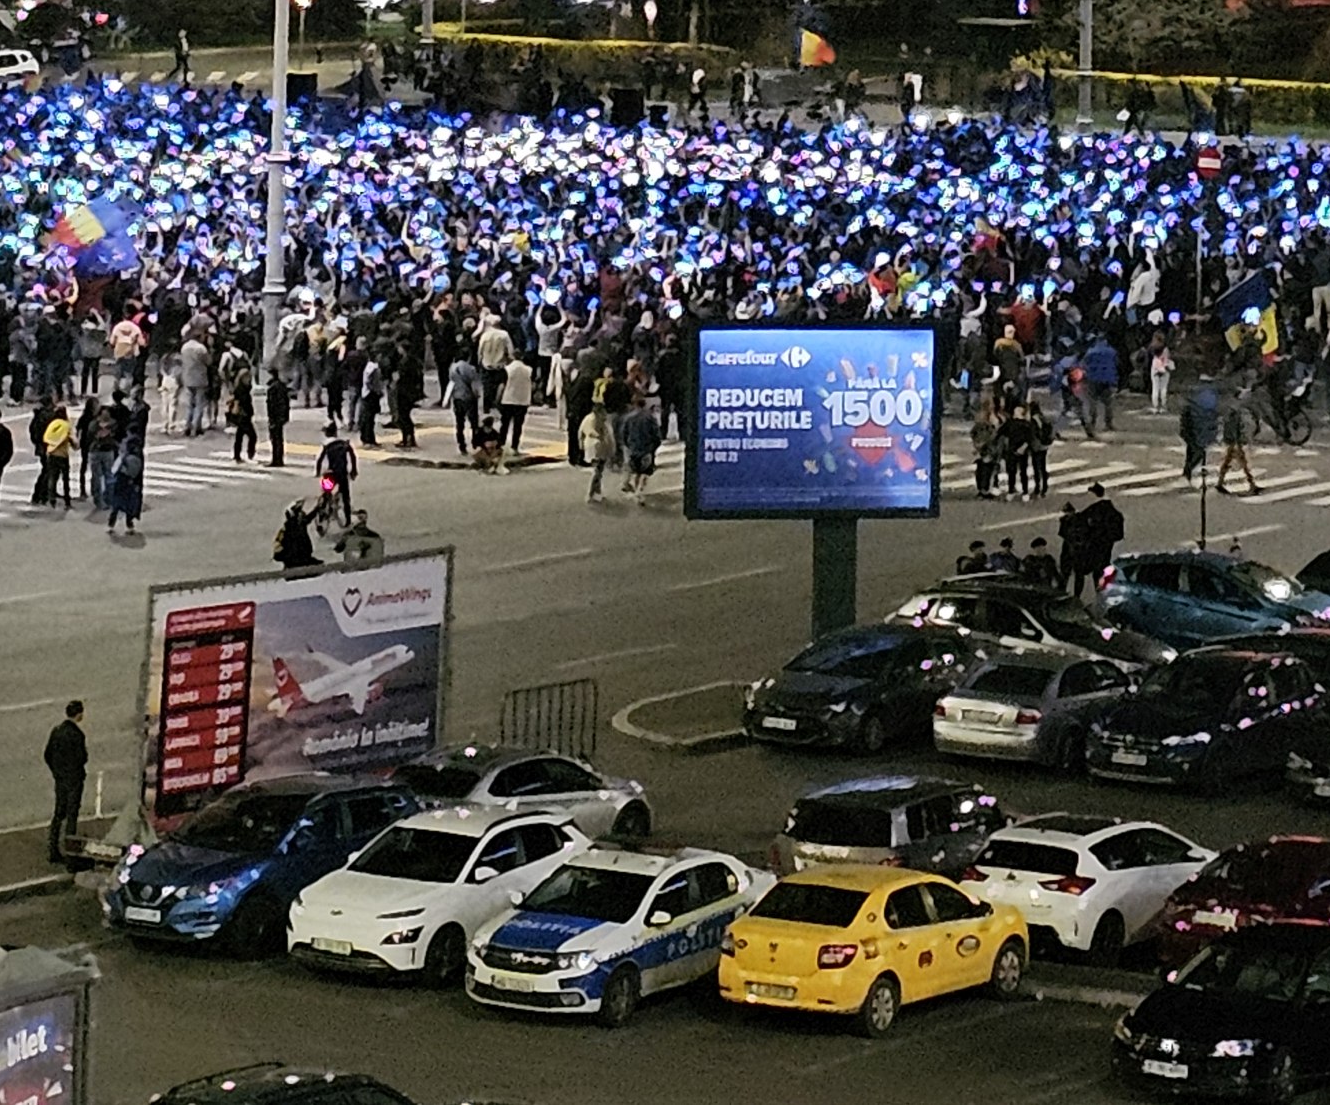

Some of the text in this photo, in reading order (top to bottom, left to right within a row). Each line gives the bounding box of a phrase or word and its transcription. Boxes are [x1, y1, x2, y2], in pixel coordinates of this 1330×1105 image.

[705, 349, 778, 367] Carrefour
[705, 388, 803, 407] REDUCEM
[822, 390, 923, 427] 1500
[705, 411, 812, 435] PREȚURILE
